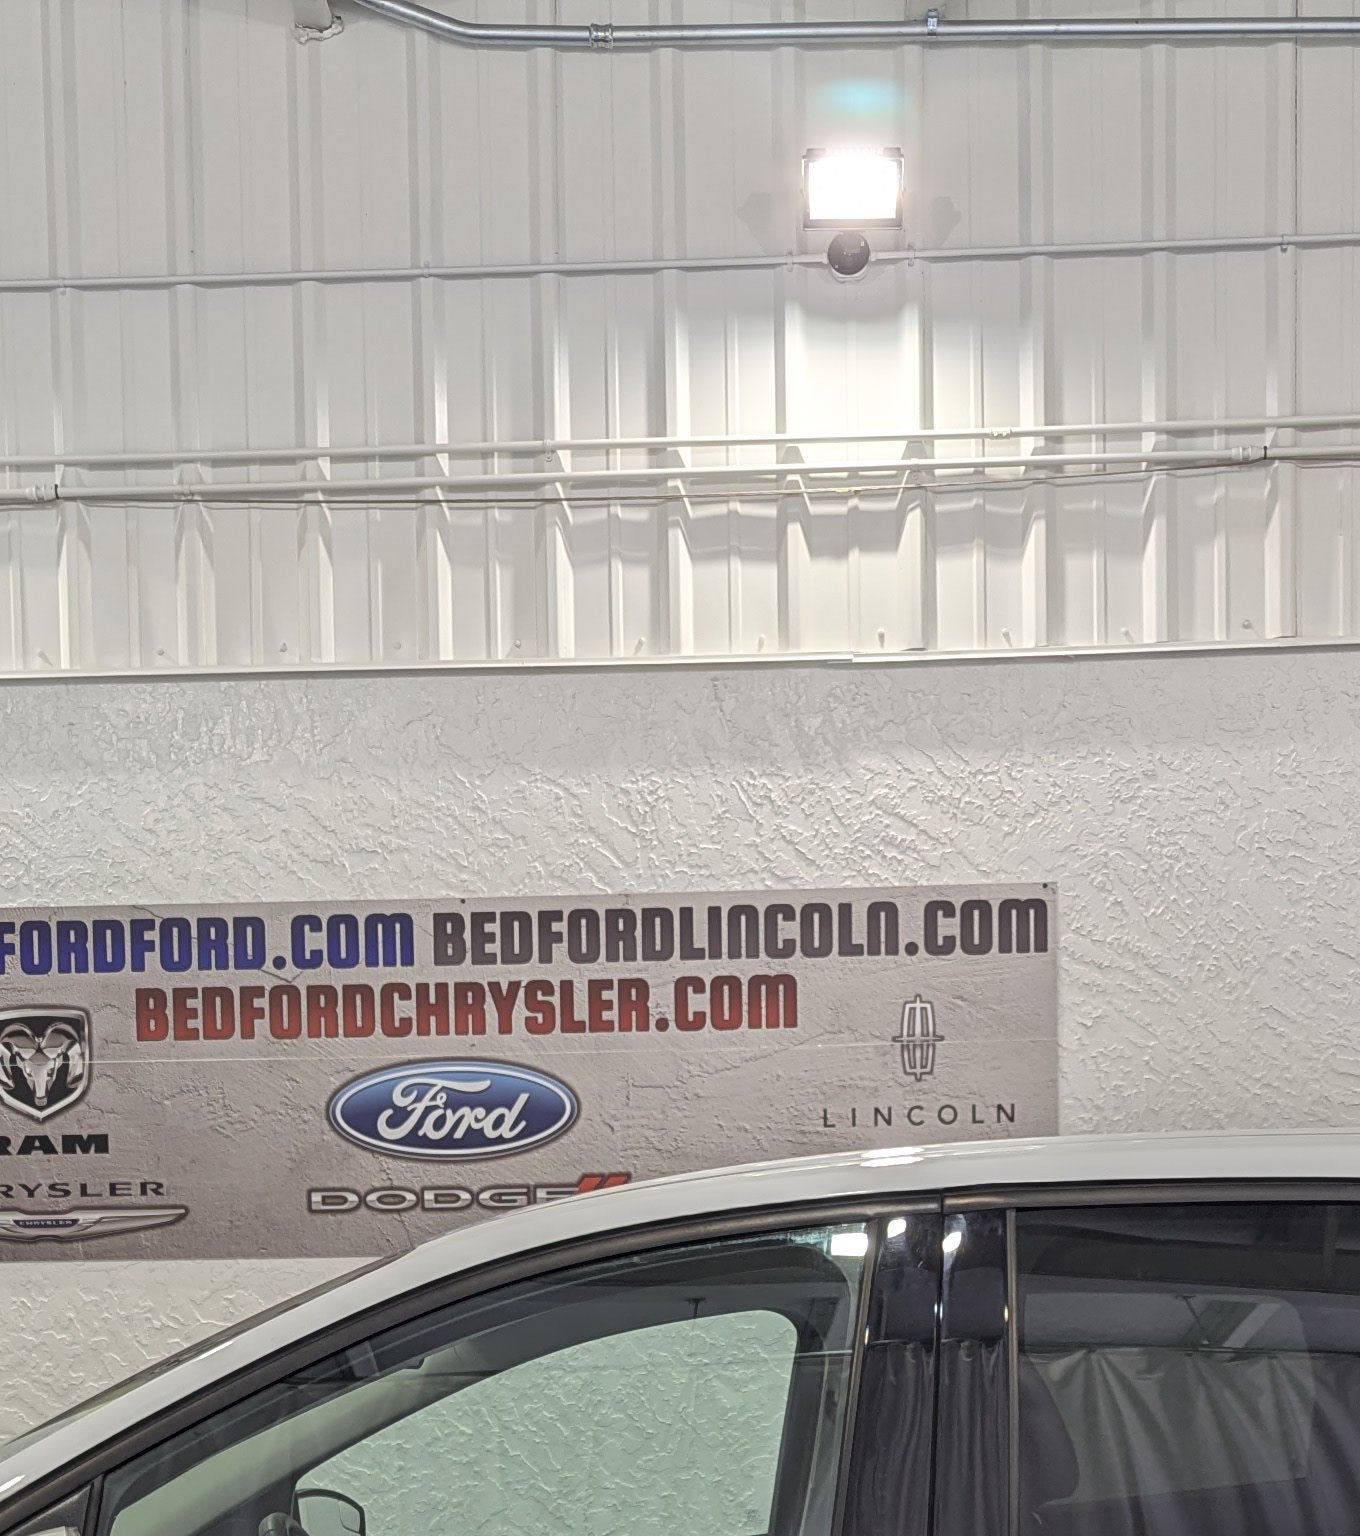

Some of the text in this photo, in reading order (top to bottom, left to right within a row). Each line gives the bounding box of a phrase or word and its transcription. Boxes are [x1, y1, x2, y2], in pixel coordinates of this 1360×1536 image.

[432, 898, 1049, 967] BEDFORDLINCOLN.COM
[134, 974, 799, 1042] BEDFORDCHRYSLER.COM
[377, 1077, 531, 1141] Ford
[822, 1103, 1016, 1129] LINCOLN
